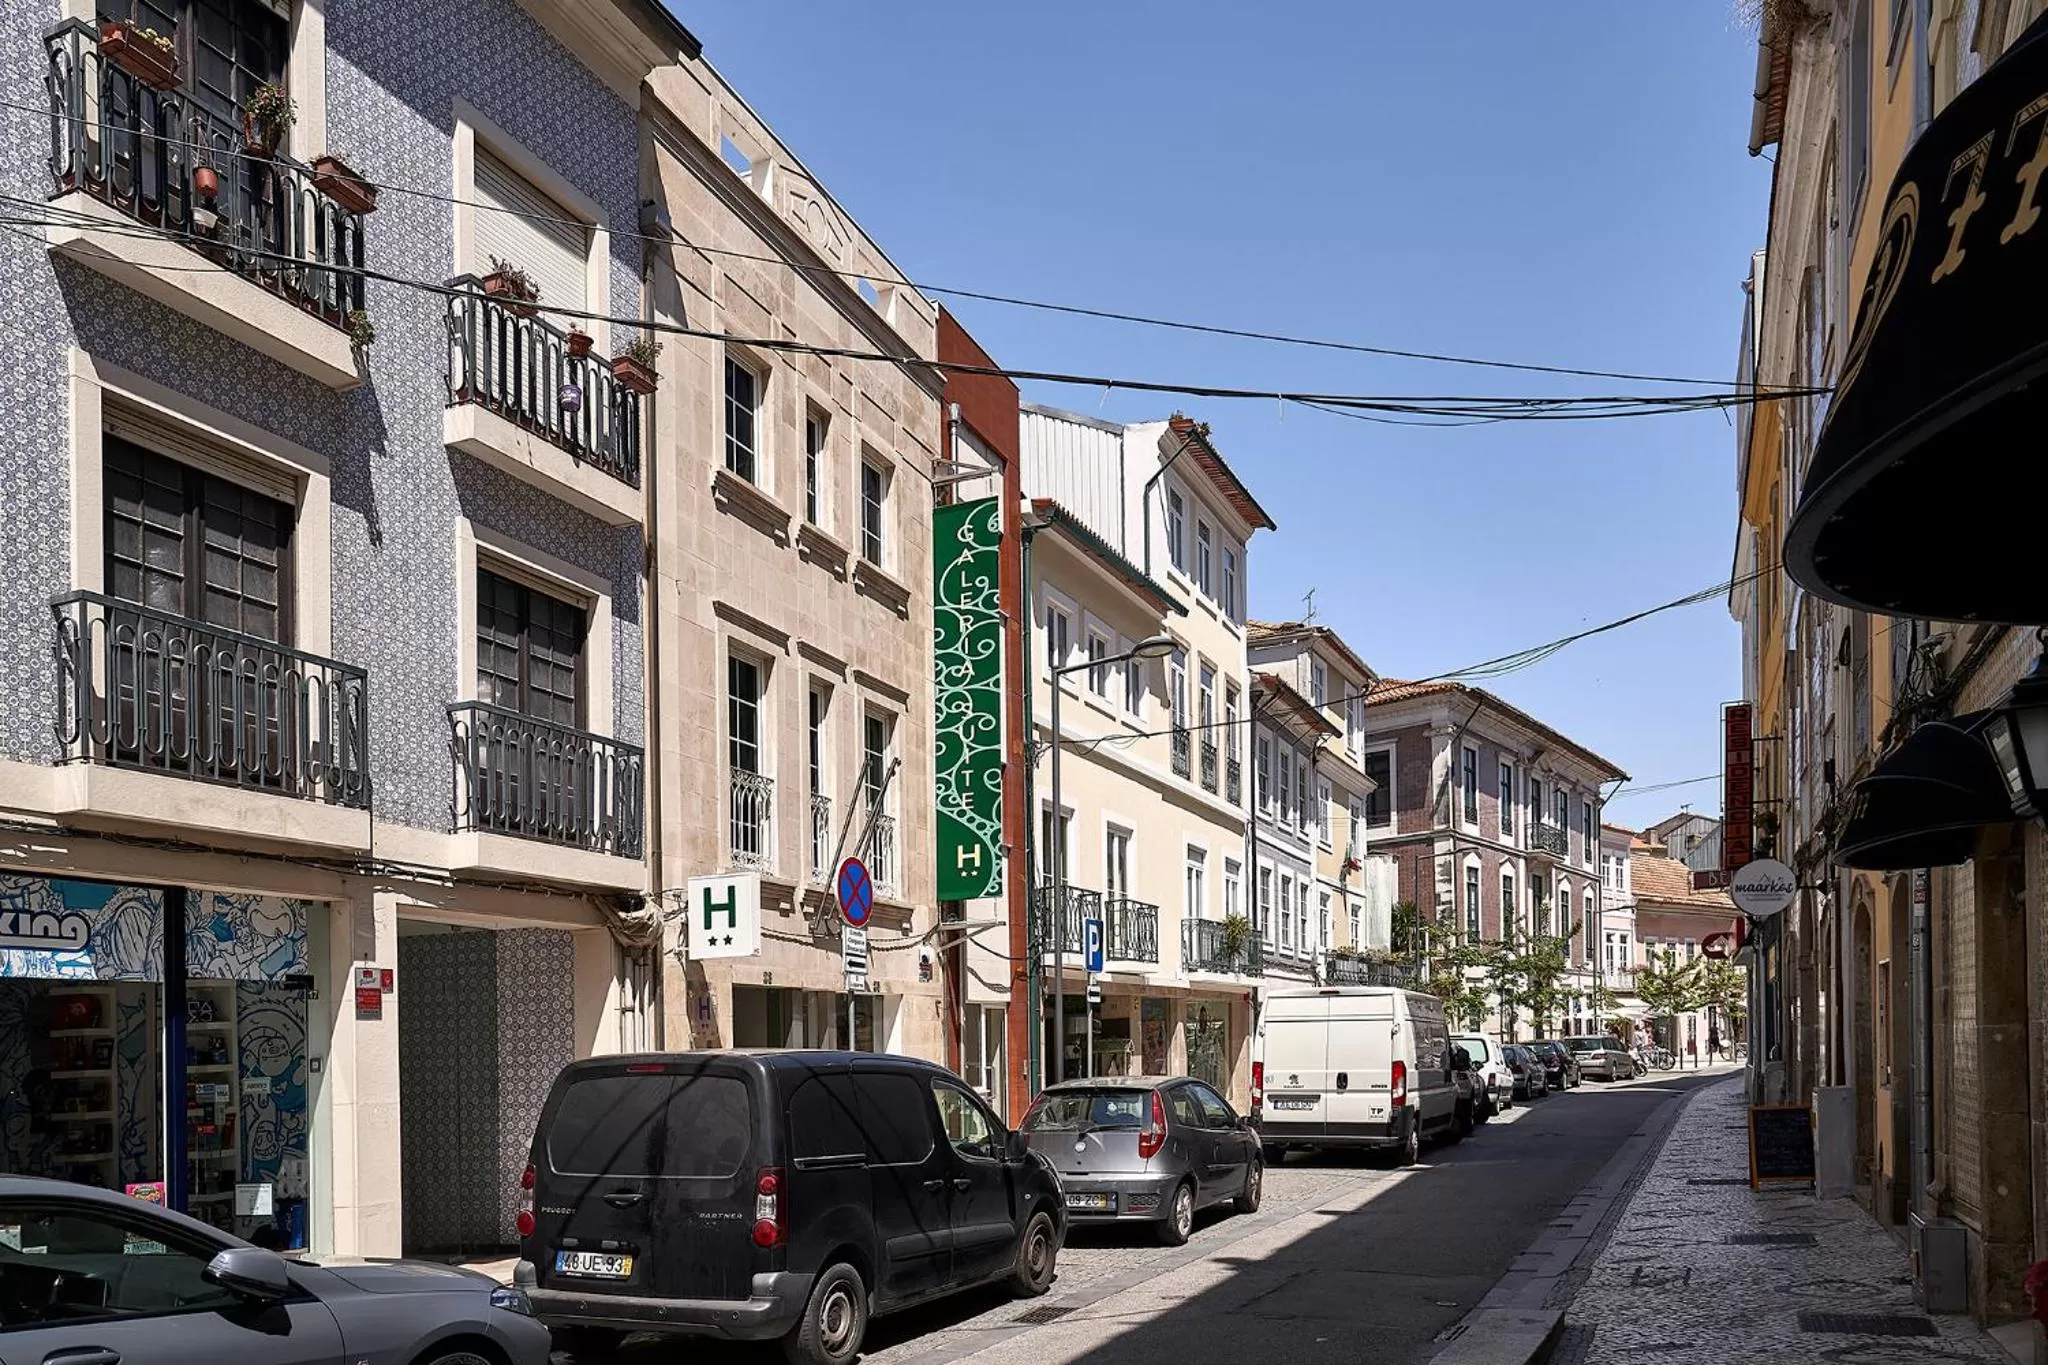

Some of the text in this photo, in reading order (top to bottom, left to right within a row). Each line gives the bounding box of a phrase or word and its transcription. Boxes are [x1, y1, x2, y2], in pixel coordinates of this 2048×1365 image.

[956, 523, 976, 810] GALERIA SUITE
[1728, 708, 1749, 866] RESIDENCIAL
[957, 844, 981, 871] H
[703, 885, 737, 930] H
[1089, 924, 1100, 970] P
[698, 1212, 744, 1220] PARTNER
